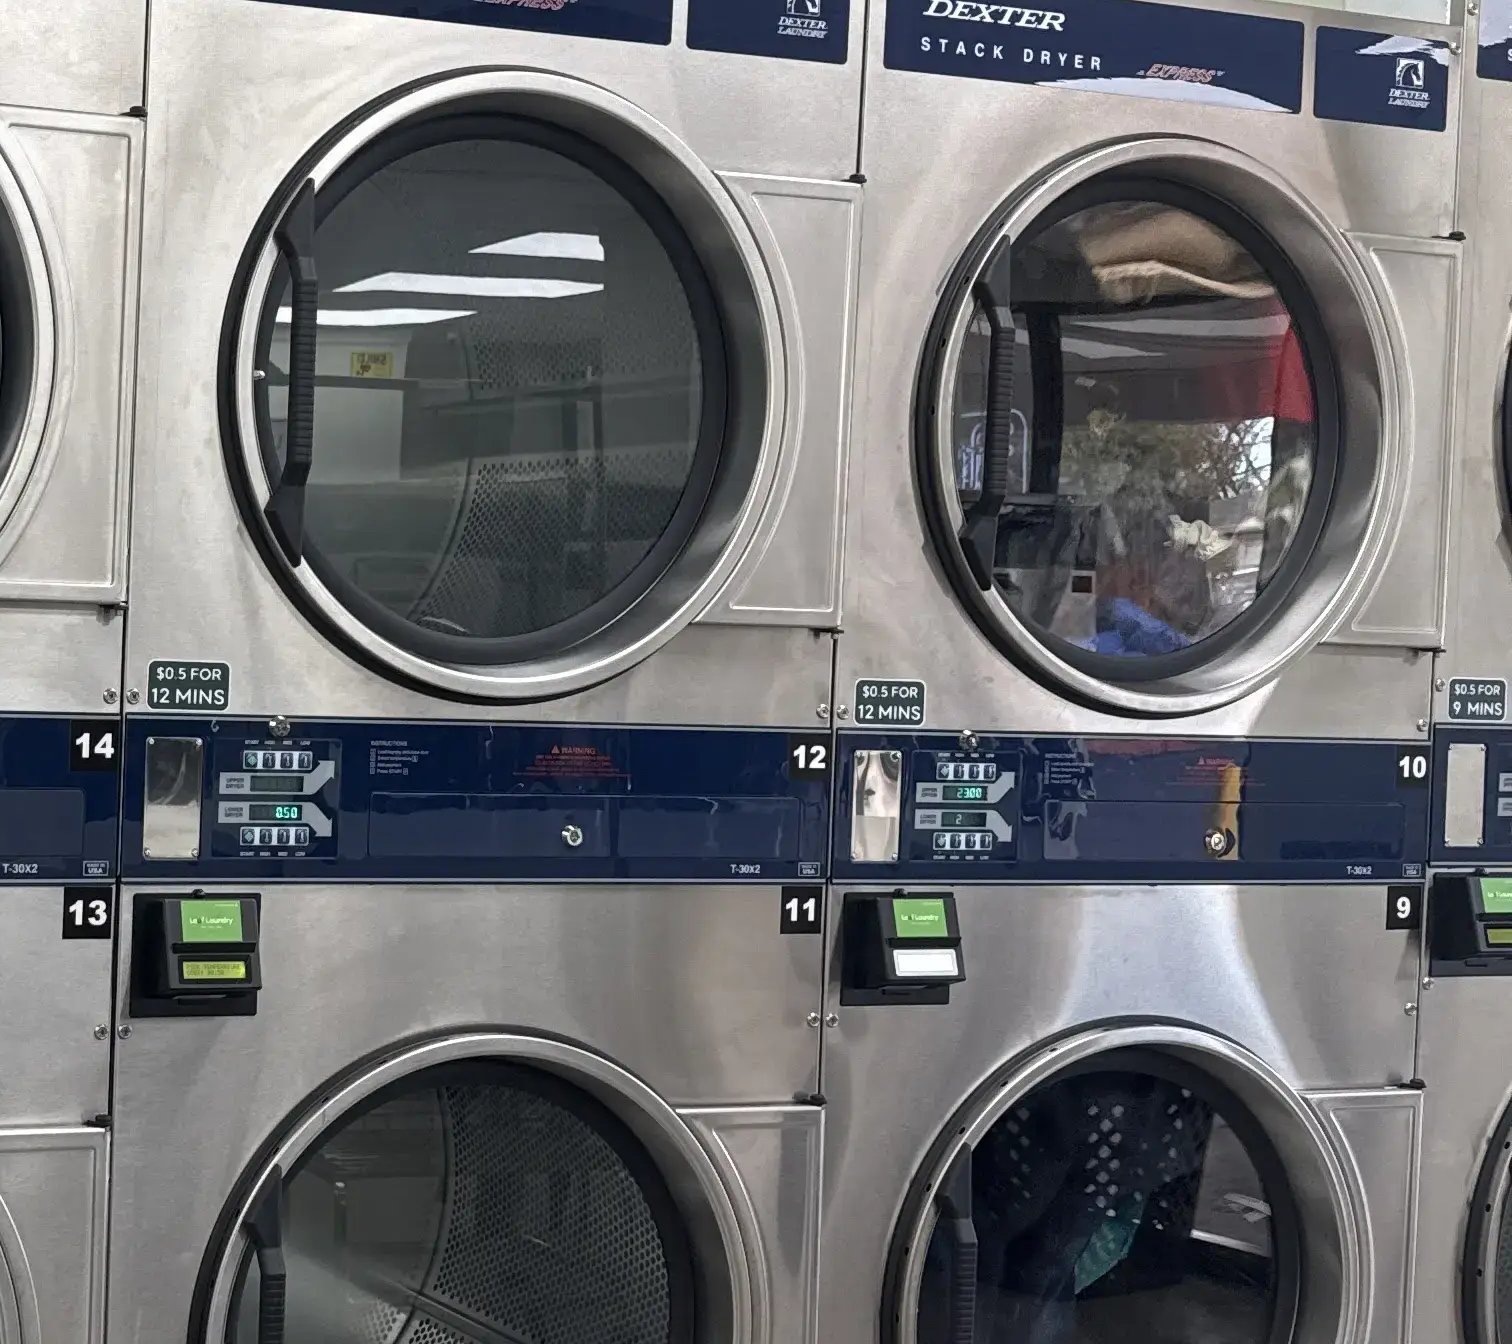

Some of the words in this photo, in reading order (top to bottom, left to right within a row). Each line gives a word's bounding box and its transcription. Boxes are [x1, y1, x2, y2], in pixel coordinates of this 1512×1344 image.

[778, 17, 826, 29] DEXTER
[777, 26, 828, 39] LAUNDRY
[920, 37, 1004, 60] STACK
[1024, 48, 1102, 71] DRYER
[1146, 64, 1215, 83] EXPRESS
[1389, 89, 1429, 100] DEXTER
[156, 667, 186, 680] $0.5
[191, 667, 221, 681] FOR
[152, 688, 170, 703] 12
[175, 689, 224, 705] MINS
[862, 686, 888, 699] $0.5
[891, 686, 918, 699] FOR
[1454, 683, 1476, 696] $0.5
[1478, 684, 1500, 696] FOR
[858, 705, 875, 719] 12
[879, 706, 920, 720] MINS
[1453, 702, 1461, 715] 9
[1467, 702, 1503, 716] MINS
[75, 732, 114, 758] 14
[793, 745, 826, 769] 12
[1399, 756, 1427, 778] 10
[2, 863, 38, 874] T-30X2
[730, 864, 760, 873] T-30X2
[69, 899, 107, 926] 13
[785, 897, 815, 921] 11
[1396, 896, 1411, 919] 9
